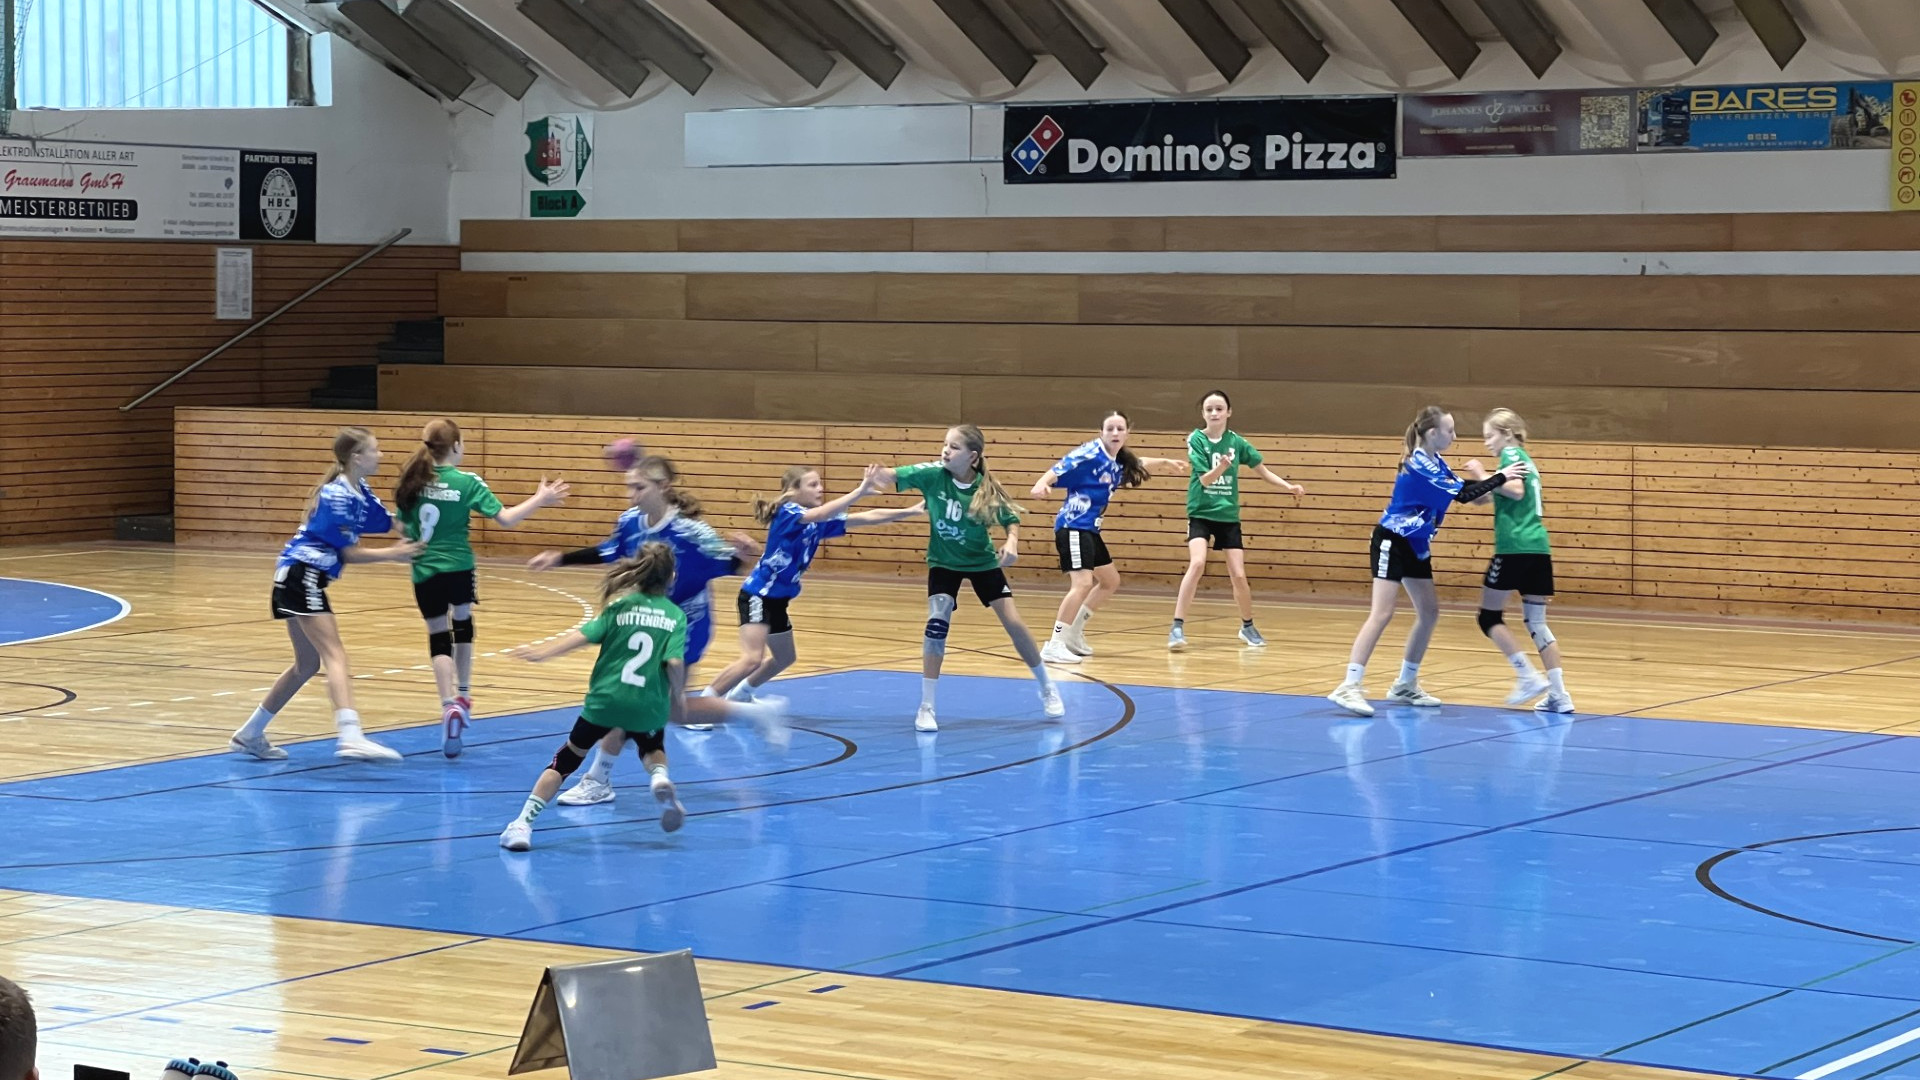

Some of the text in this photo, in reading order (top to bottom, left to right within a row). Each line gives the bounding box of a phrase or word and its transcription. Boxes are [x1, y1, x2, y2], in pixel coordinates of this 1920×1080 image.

[1689, 87, 1838, 111] BARES
[91, 150, 117, 160] ALLER
[119, 151, 135, 161] ART
[245, 154, 280, 164] PARTNER
[297, 156, 314, 165] HBC
[1068, 132, 1376, 174] Domino's Pizza
[4, 169, 126, 194] Graumann GmbH
[0, 199, 130, 218] MEISTERBETRIEB
[267, 198, 291, 208] HBC
[537, 195, 578, 210] Block A
[945, 498, 962, 521] 16
[620, 631, 654, 688] 2
